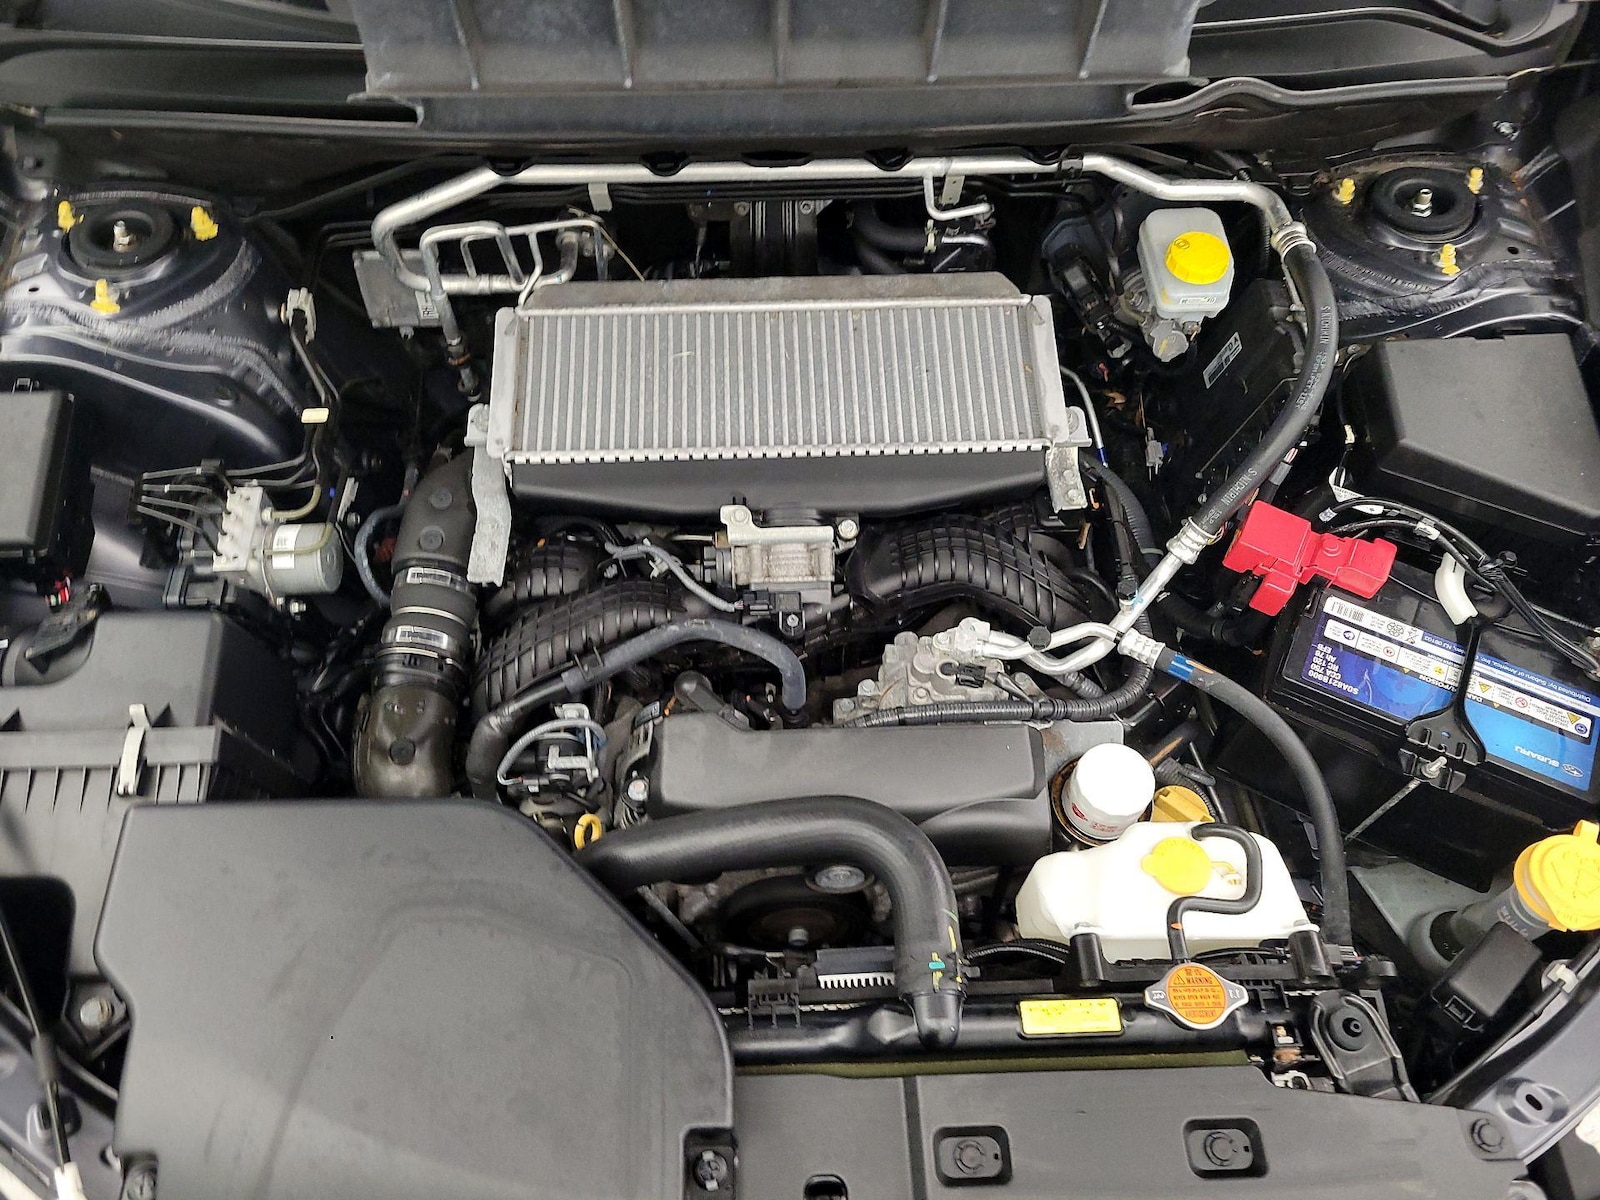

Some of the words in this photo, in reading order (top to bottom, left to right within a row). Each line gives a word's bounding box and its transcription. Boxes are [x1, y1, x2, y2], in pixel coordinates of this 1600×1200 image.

[1316, 642, 1332, 653] EFB
[1442, 641, 1452, 649] NJ
[1312, 655, 1327, 666] 120
[1324, 652, 1337, 662] Ah
[1309, 662, 1325, 673] 750
[1326, 661, 1340, 671] RC
[1324, 668, 1342, 680] CCA
[1524, 673, 1547, 685] Subaru
[1557, 684, 1591, 702] Distributed
[1514, 745, 1560, 767] SUBARU
